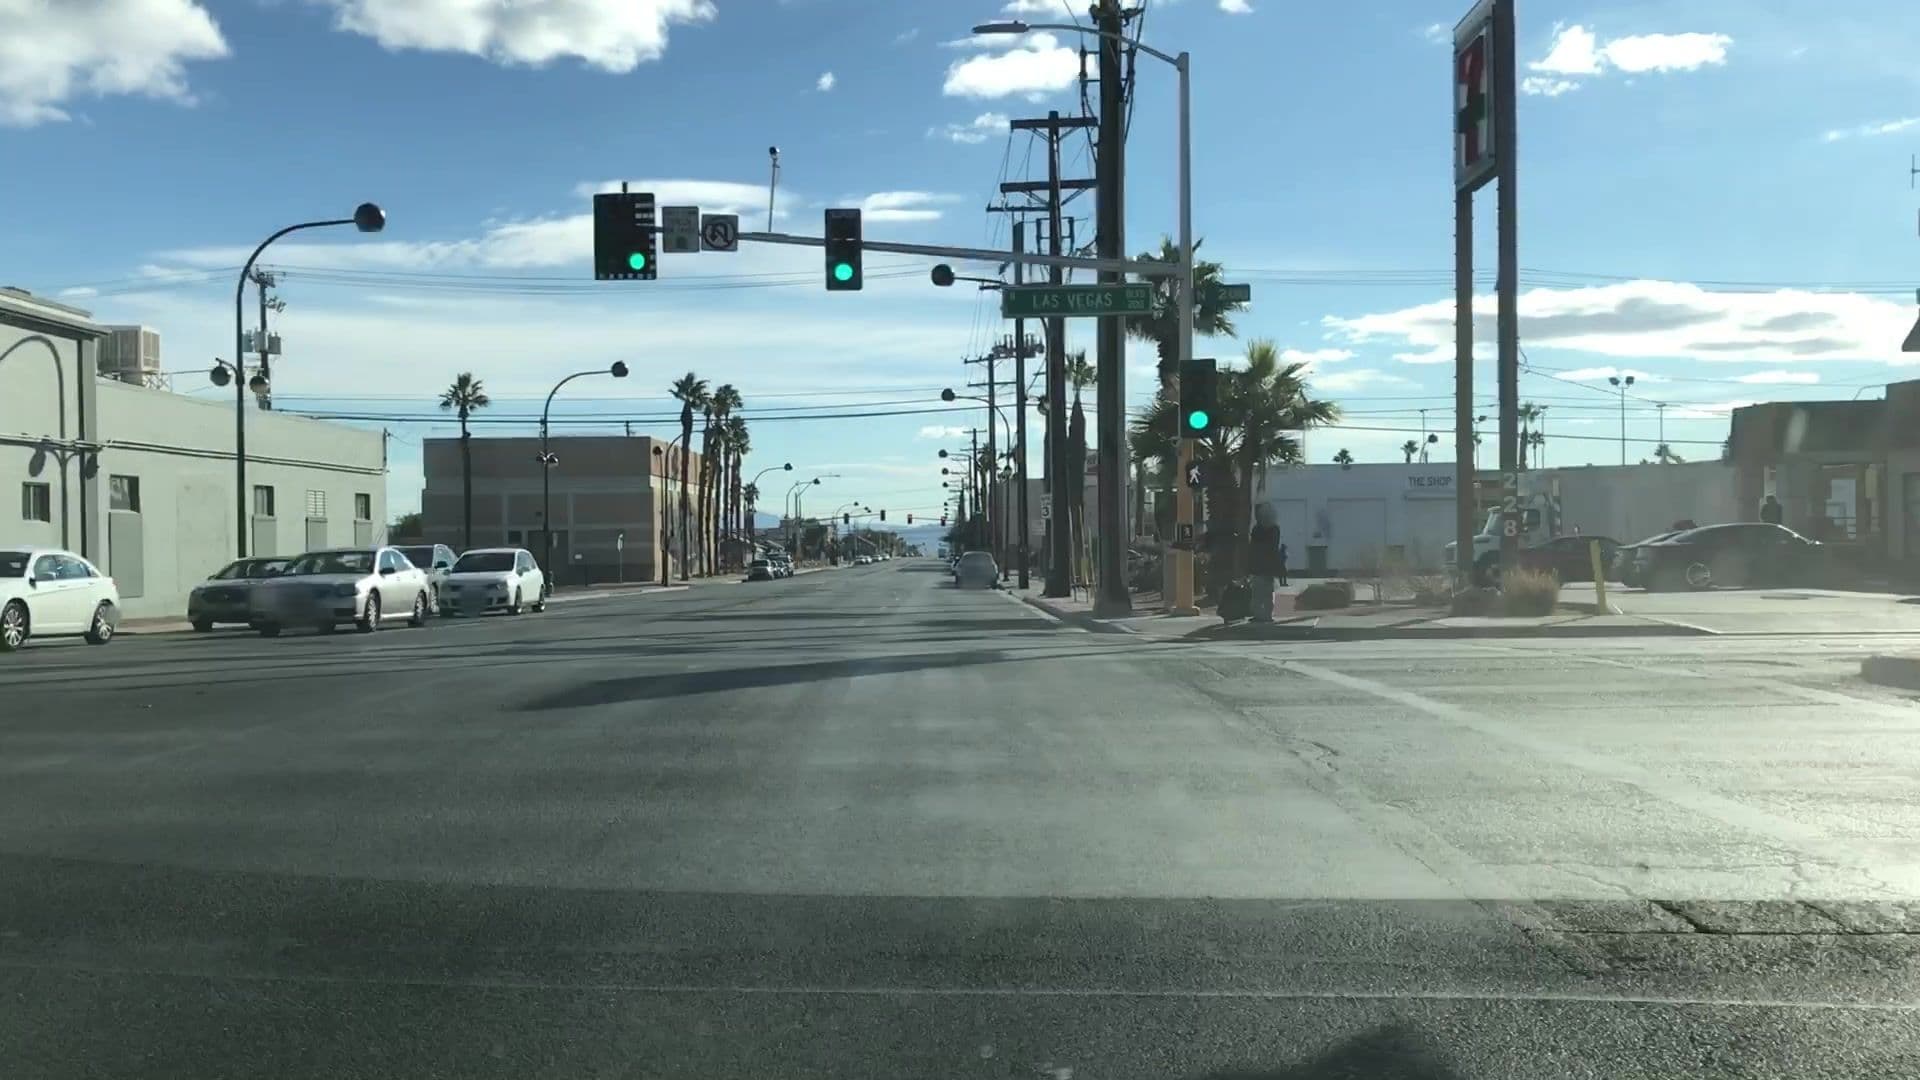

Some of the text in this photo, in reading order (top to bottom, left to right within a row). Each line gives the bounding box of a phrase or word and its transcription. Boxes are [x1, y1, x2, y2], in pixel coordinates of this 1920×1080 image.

[1032, 293, 1060, 309] LAS
[1066, 291, 1112, 310] VEGAS
[1408, 476, 1452, 487] THE SHOP
